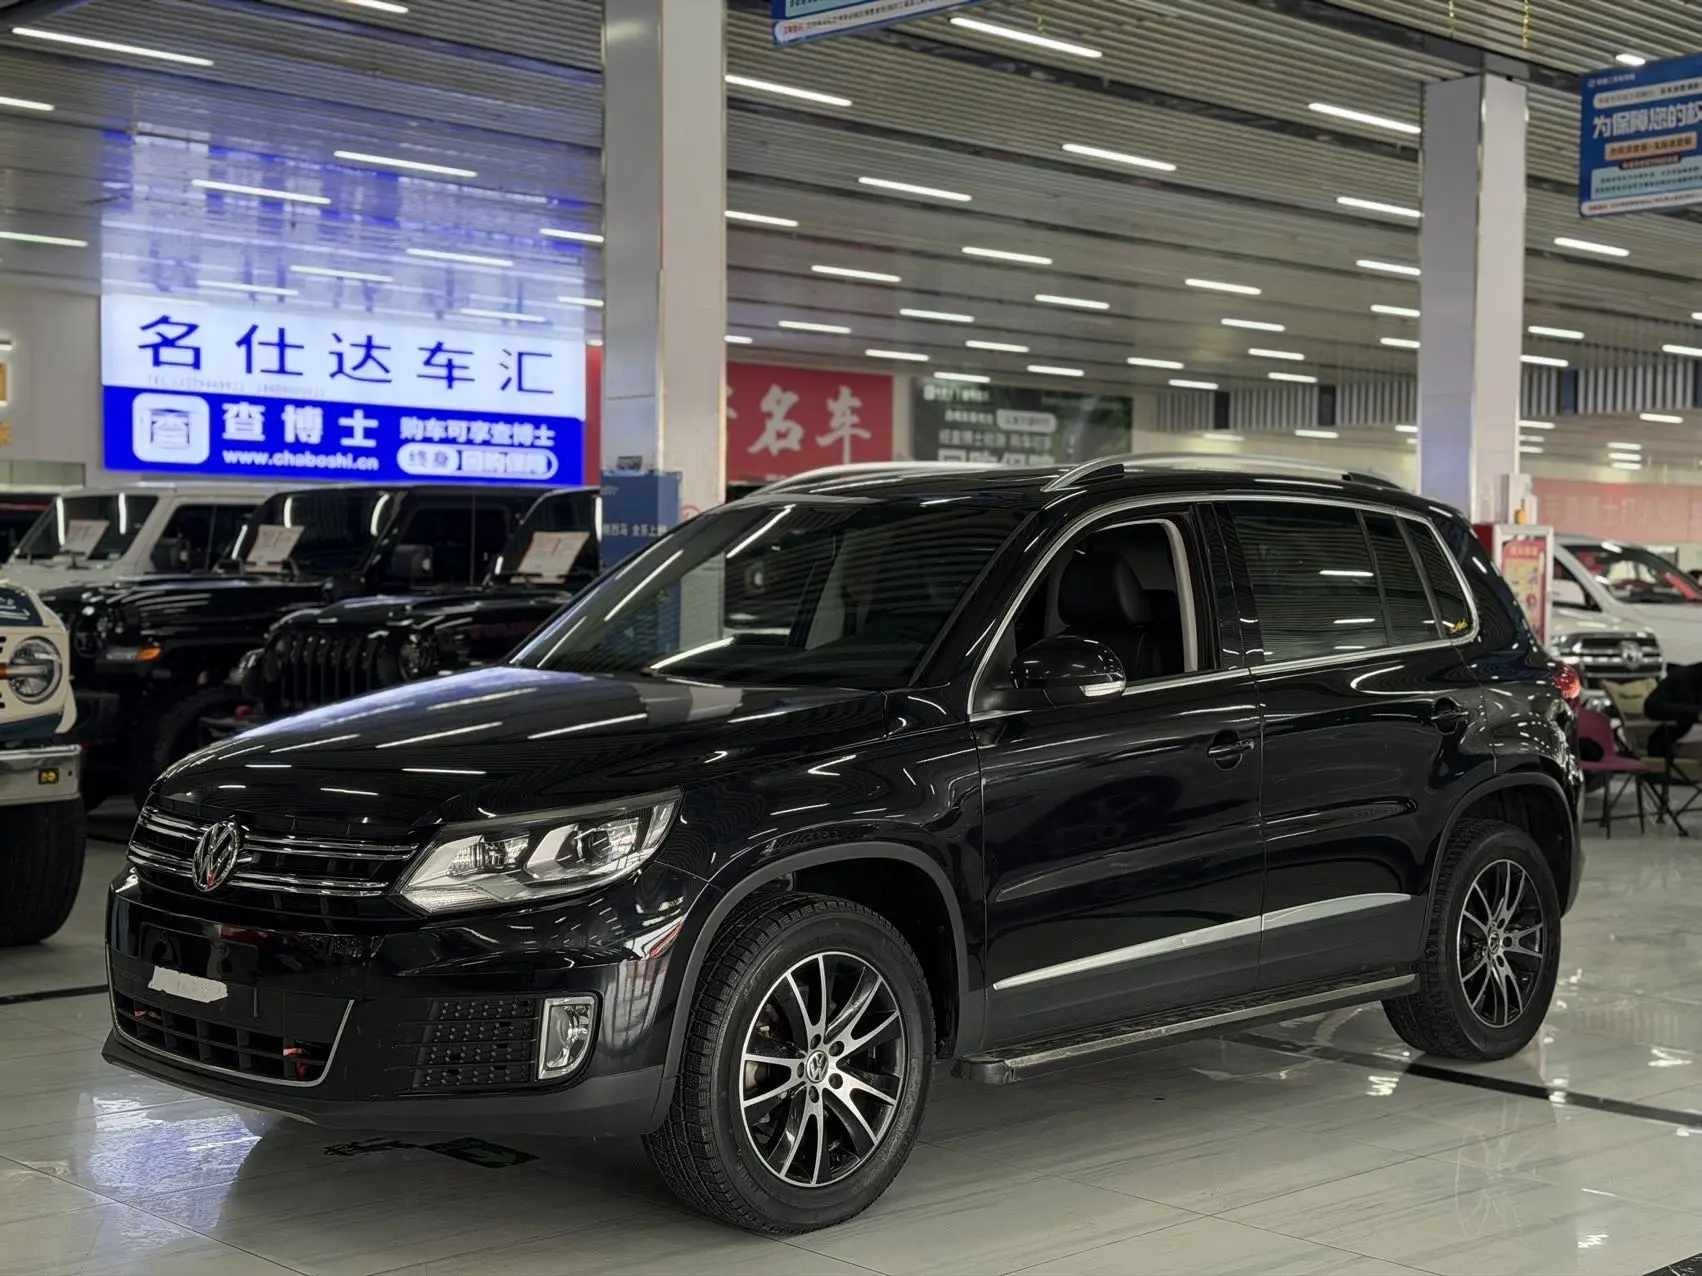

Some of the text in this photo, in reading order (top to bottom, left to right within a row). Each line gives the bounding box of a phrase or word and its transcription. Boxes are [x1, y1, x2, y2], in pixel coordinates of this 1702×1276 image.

[138, 315, 555, 394] 名仕达车汇
[222, 401, 379, 448] 查博士
[400, 416, 557, 447] 购车可享查博士
[727, 383, 873, 464] 名车
[222, 449, 379, 471] www.chaboshi.cn
